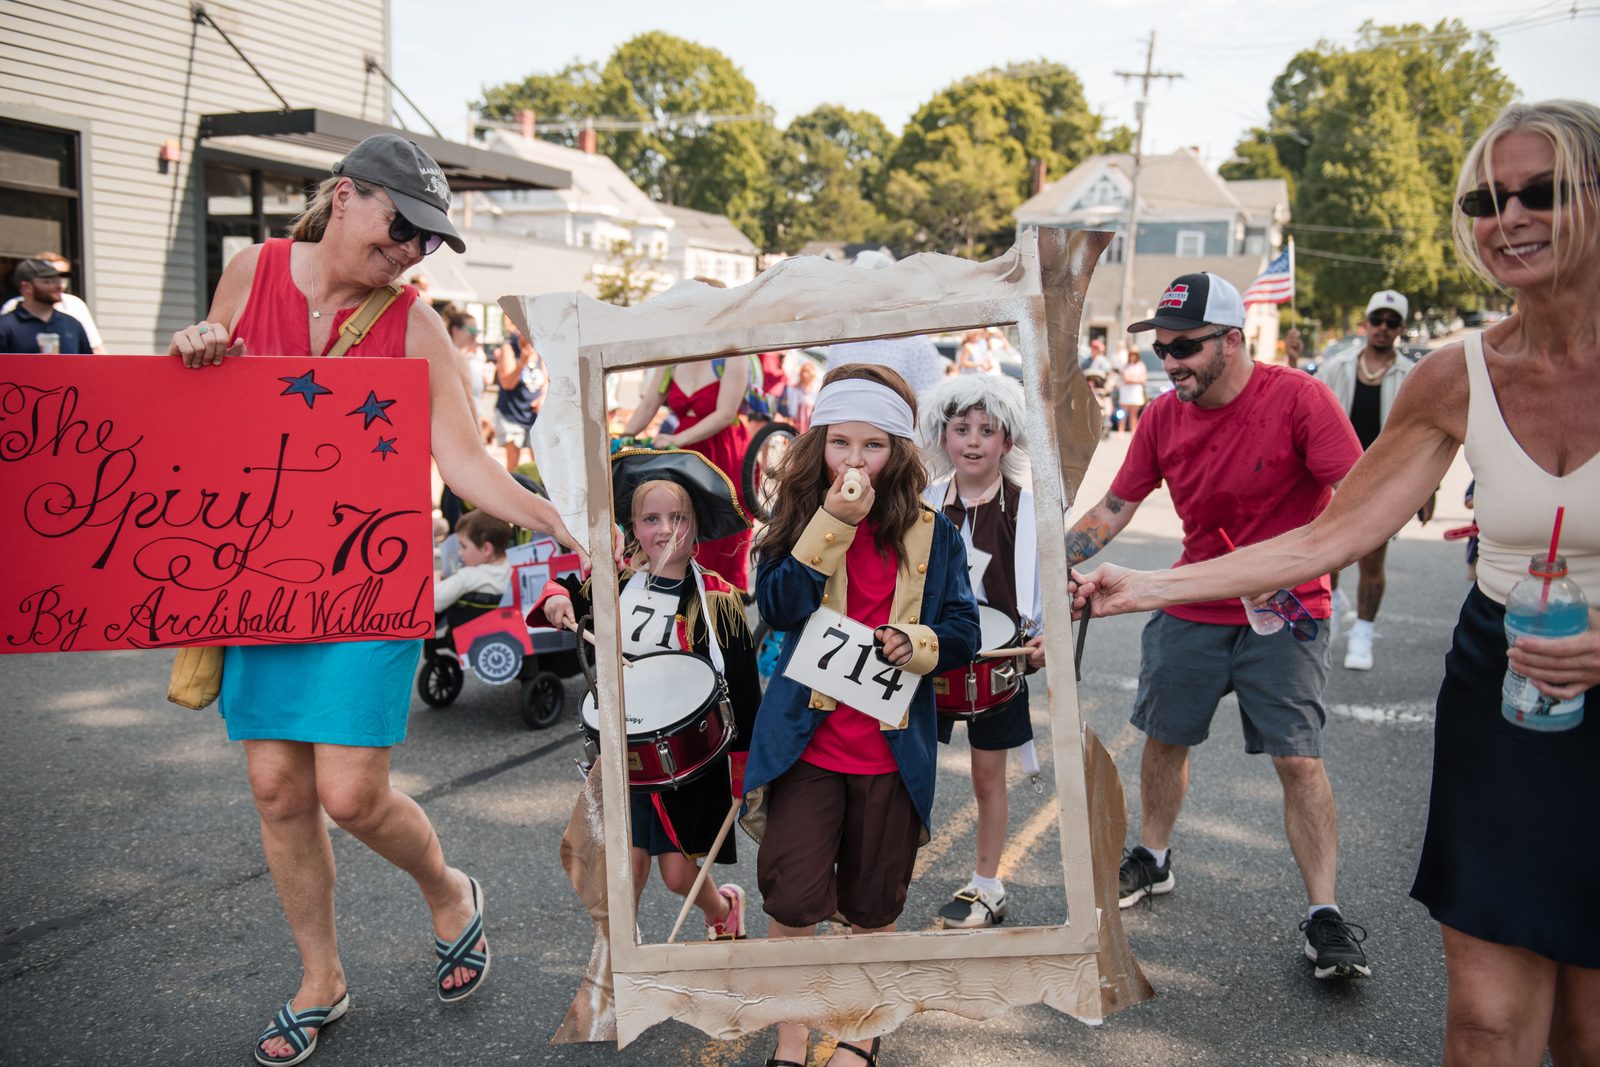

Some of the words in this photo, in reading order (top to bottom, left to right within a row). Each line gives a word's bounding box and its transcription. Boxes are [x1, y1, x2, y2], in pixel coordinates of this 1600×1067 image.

[0, 382, 144, 462] The
[24, 433, 341, 570] Spirit
[168, 517, 274, 591] of
[7, 585, 88, 651] By
[104, 586, 296, 641] Archibald
[305, 576, 432, 639] Willard
[817, 626, 903, 700] 714
